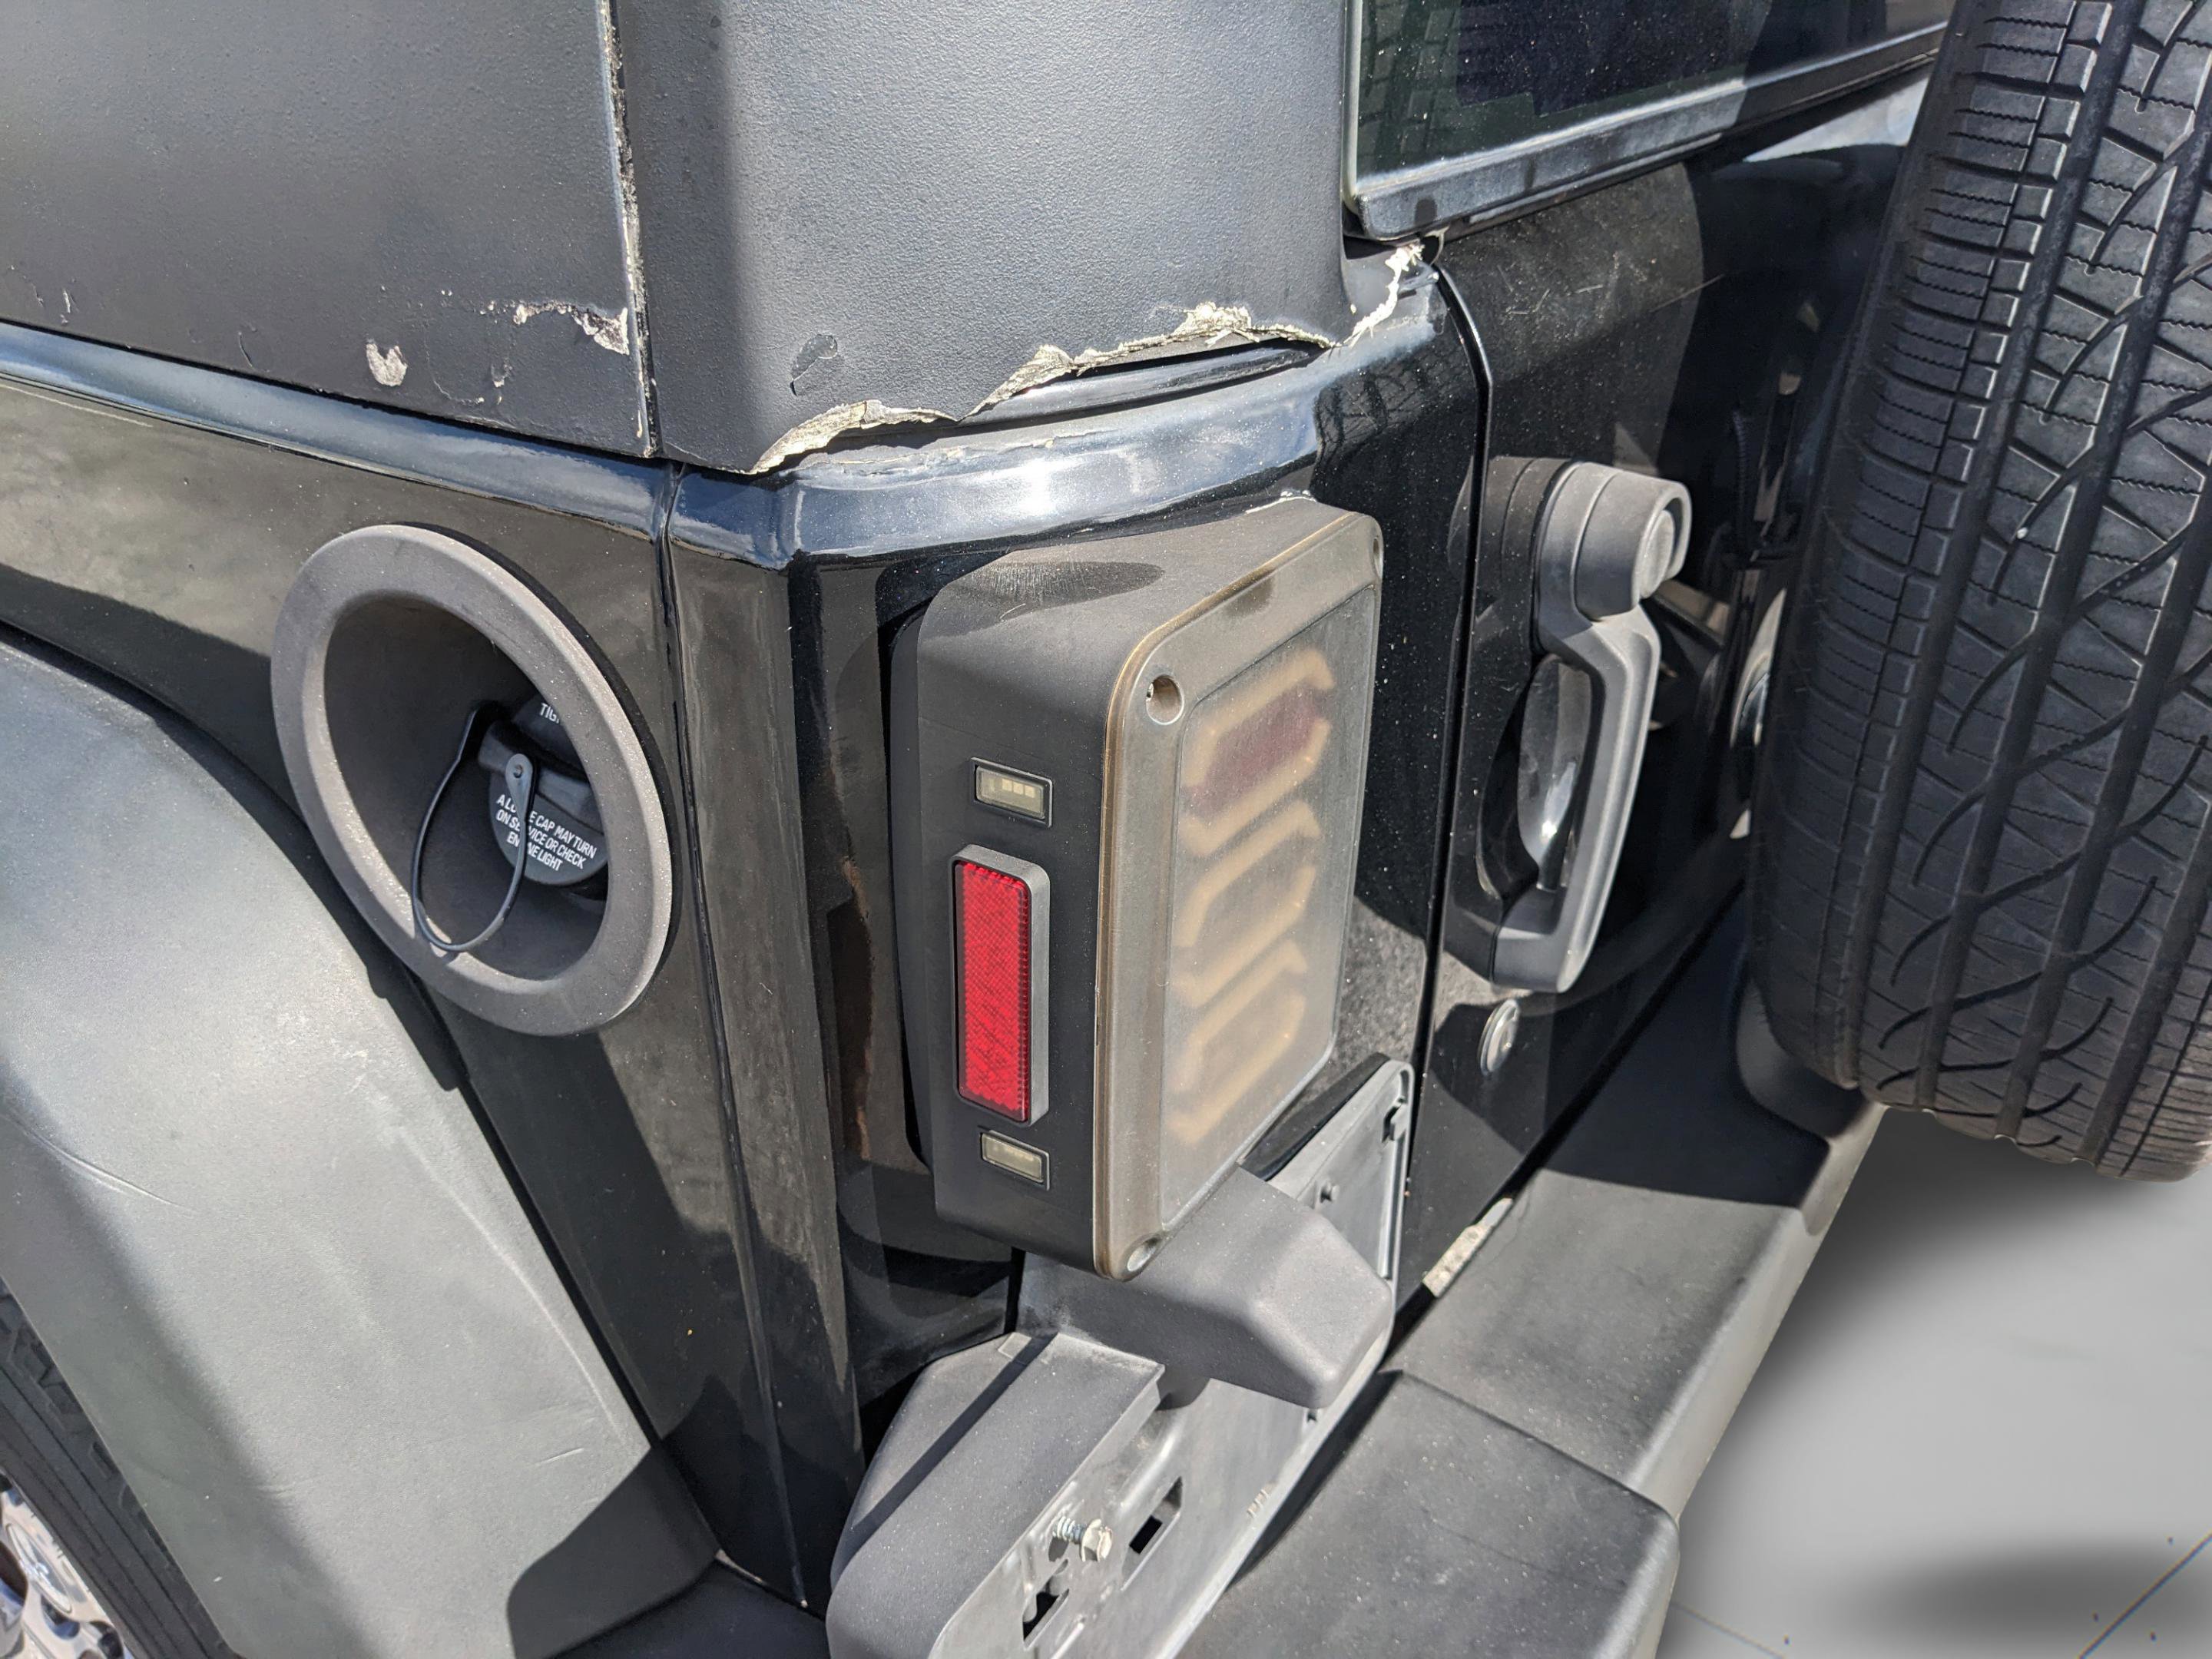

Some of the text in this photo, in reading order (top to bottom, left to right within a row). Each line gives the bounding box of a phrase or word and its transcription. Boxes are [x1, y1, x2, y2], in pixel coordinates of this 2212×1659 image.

[540, 702, 560, 724] TIG
[496, 794, 505, 806] A
[535, 815, 555, 831] CAP
[554, 825, 575, 844] MAY
[572, 836, 598, 859] TURN
[496, 809, 587, 869] ON SEVICE OR CHECK
[507, 831, 564, 871] ENNE LIGHT
